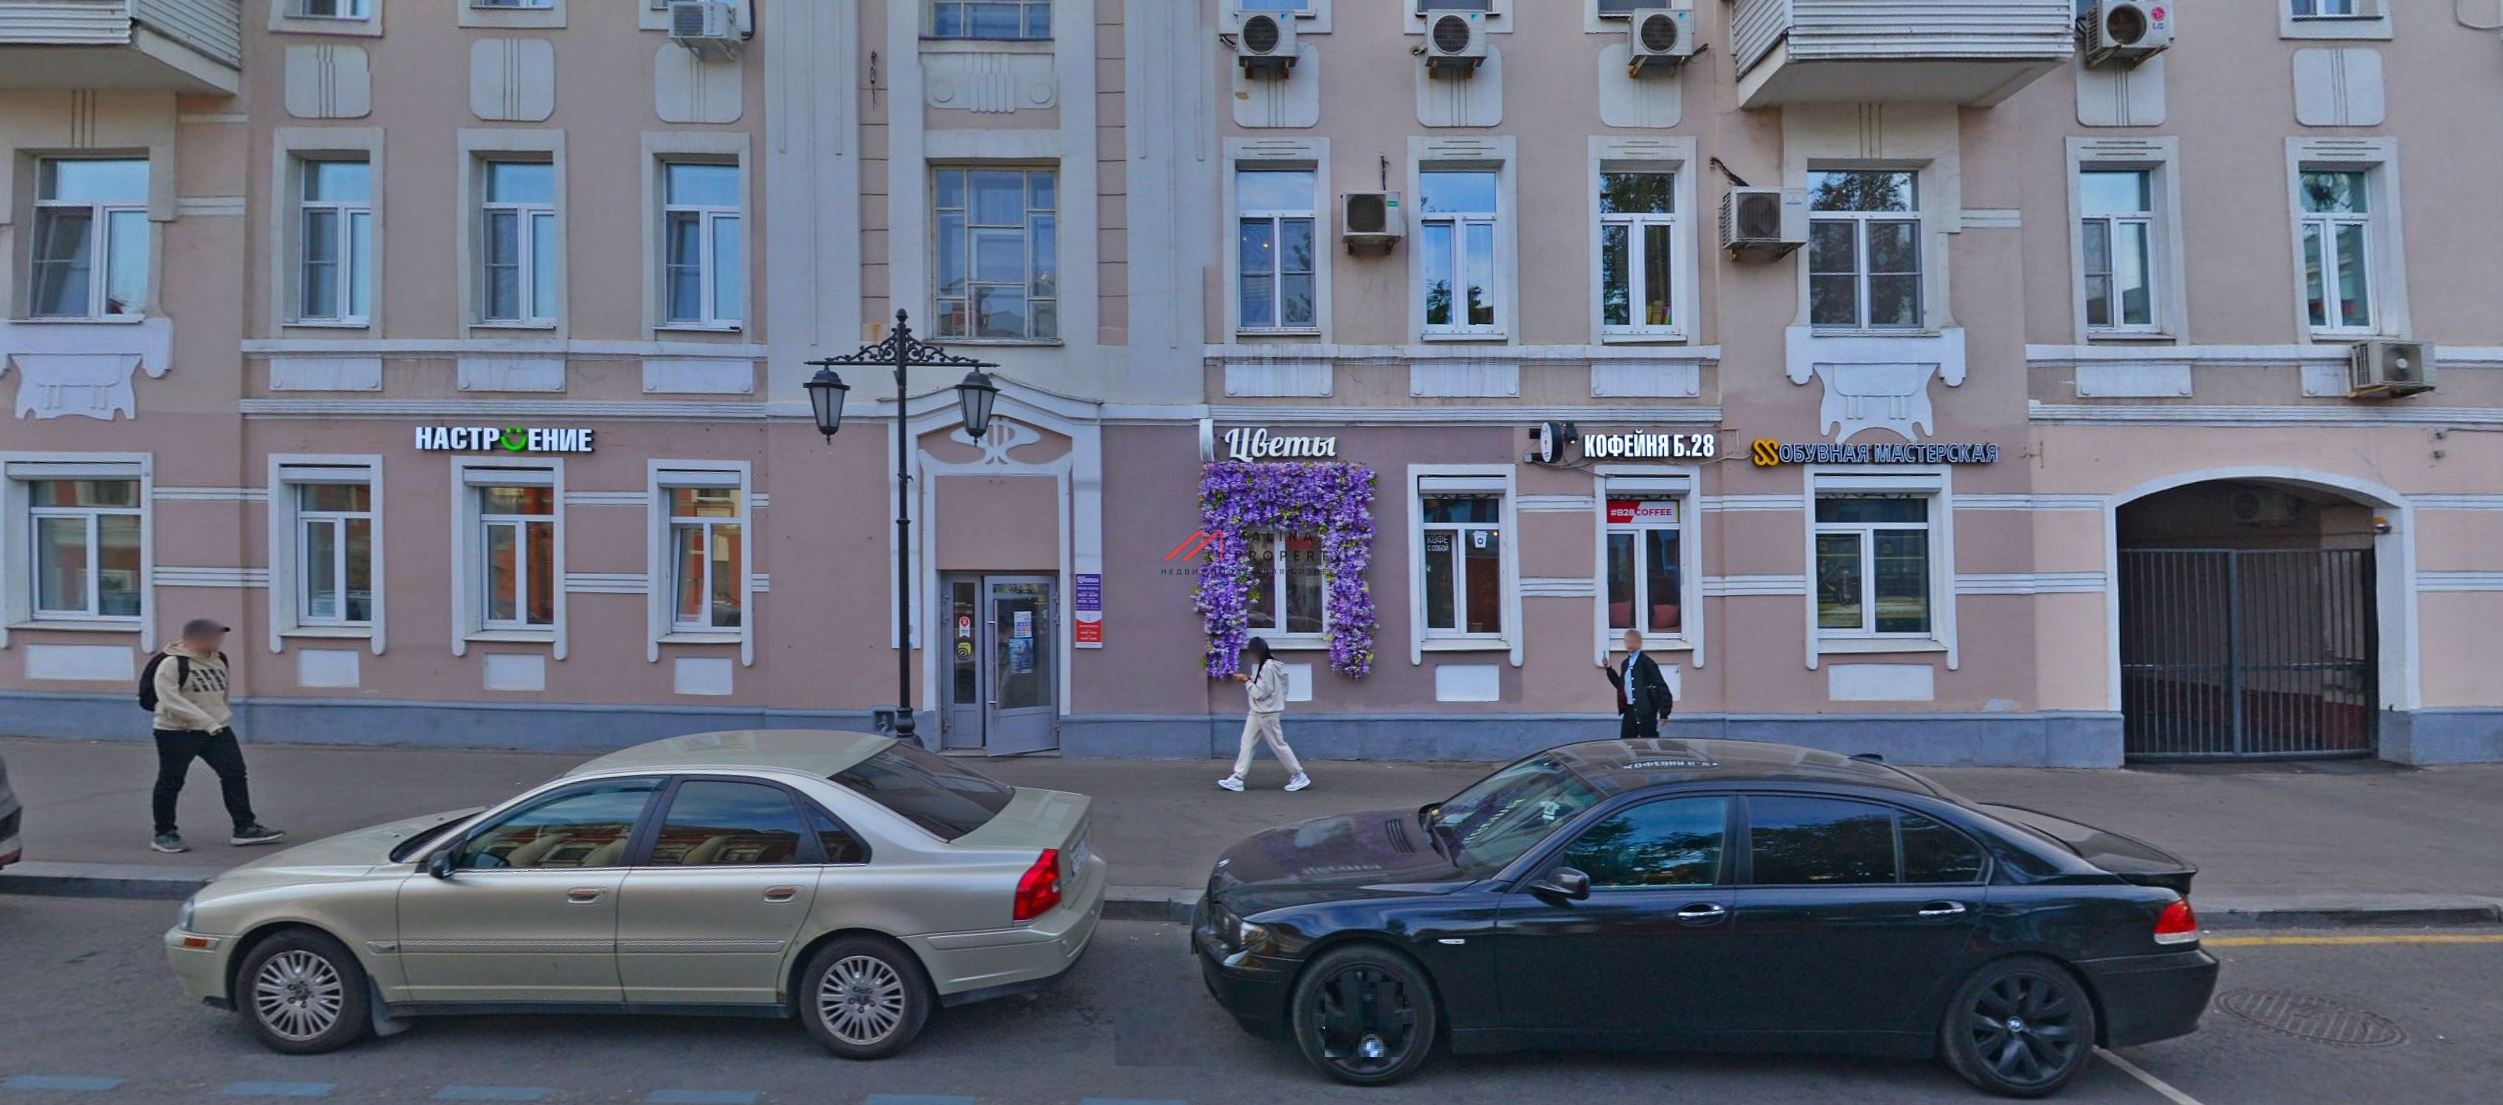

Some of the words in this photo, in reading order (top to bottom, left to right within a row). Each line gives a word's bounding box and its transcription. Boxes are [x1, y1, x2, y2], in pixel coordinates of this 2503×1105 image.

[1225, 427, 1336, 462] Цветы
[1584, 429, 1669, 458] КОФЕЙНЯ
[1673, 433, 1715, 458] Б.28
[1779, 443, 1869, 463] ОБУВНАЯ
[1874, 443, 1998, 463] МАСТЕРСКАЯ
